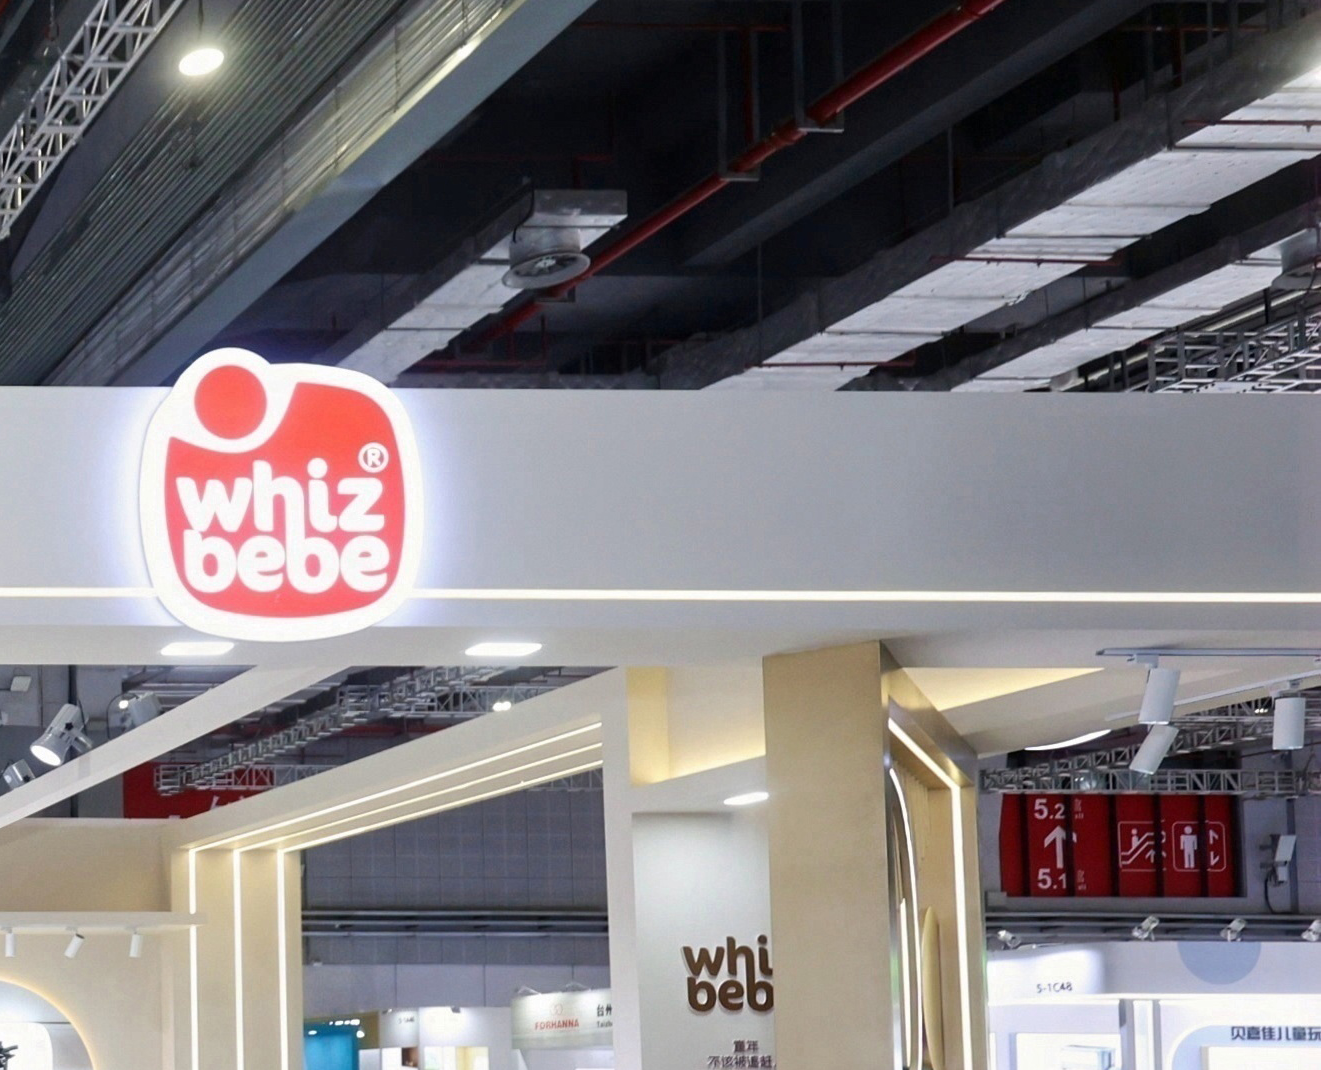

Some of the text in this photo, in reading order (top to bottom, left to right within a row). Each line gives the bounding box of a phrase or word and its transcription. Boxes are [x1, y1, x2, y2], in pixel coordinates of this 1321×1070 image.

[175, 457, 385, 533] whiz
[183, 529, 391, 594] bebe
[1033, 798, 1066, 820] 5.2
[1037, 868, 1067, 890] 5.1
